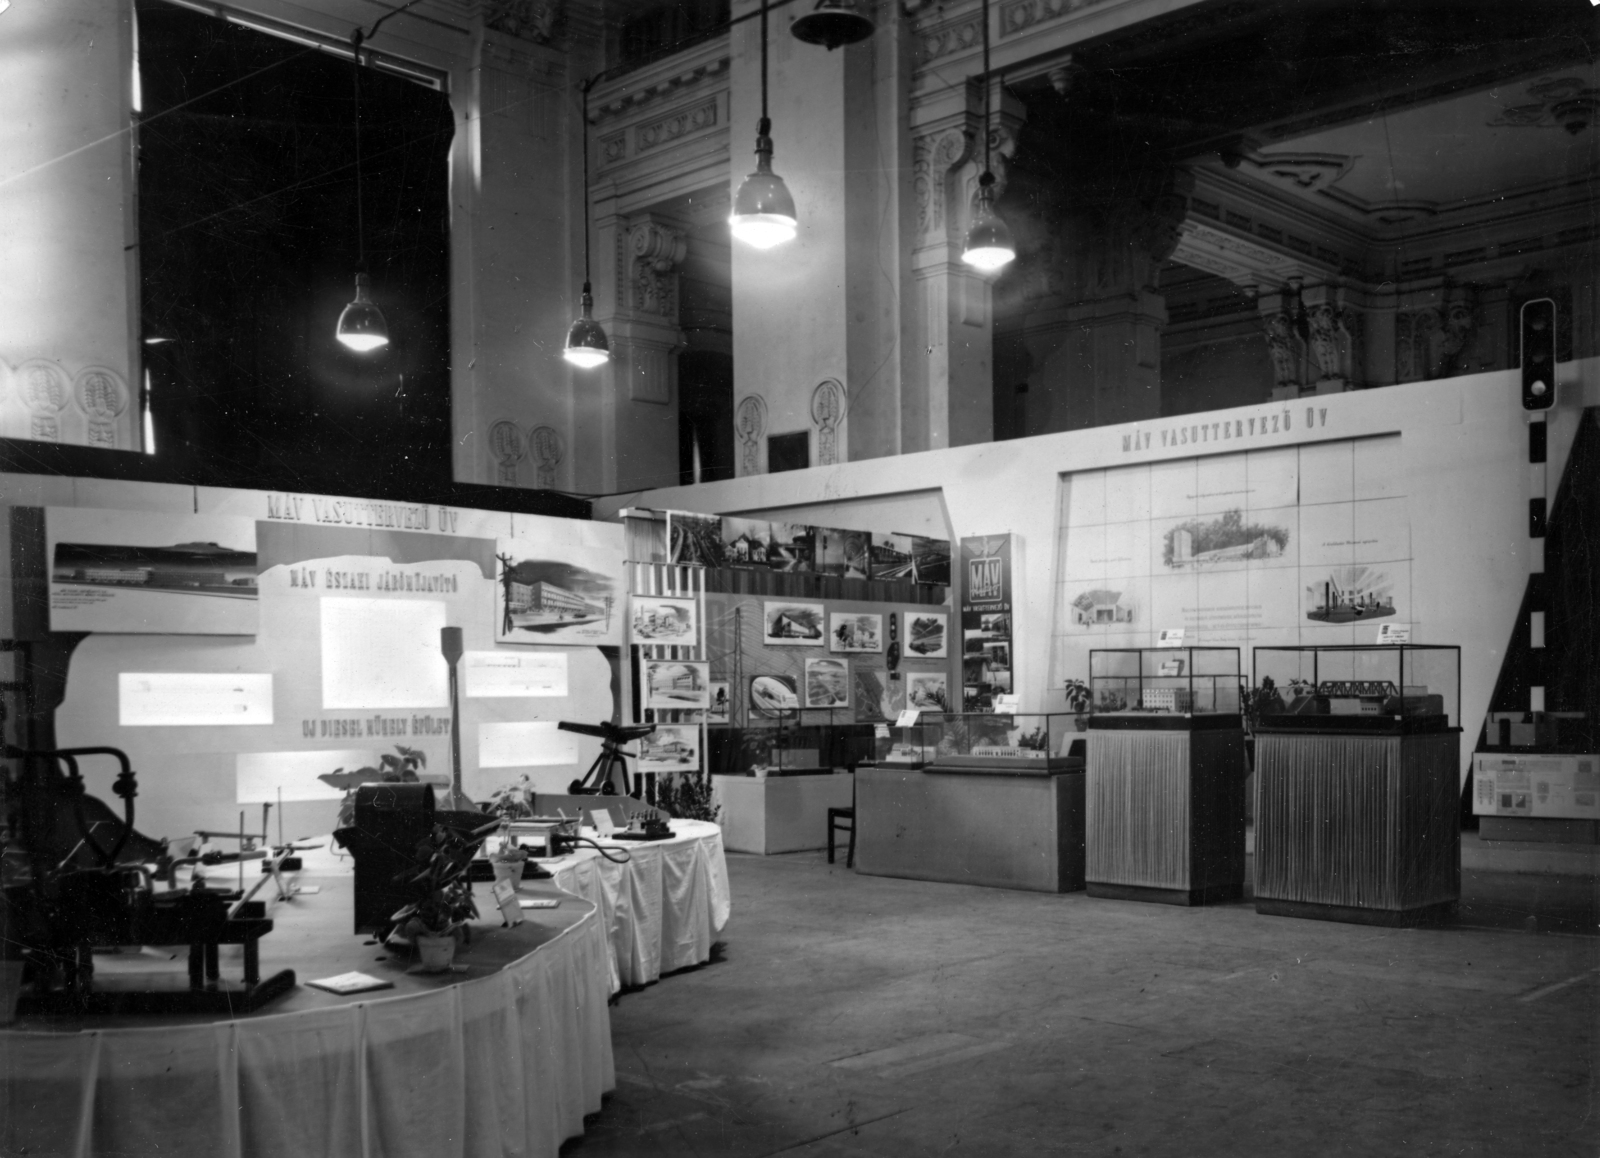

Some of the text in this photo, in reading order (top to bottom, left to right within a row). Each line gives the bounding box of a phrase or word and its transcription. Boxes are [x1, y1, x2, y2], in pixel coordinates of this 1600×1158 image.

[1122, 429, 1151, 452] MÁV
[267, 493, 303, 521] MÁV
[290, 567, 316, 589] MÁV
[326, 568, 370, 591] ÉSZAKI
[320, 719, 363, 738] DIESEL
